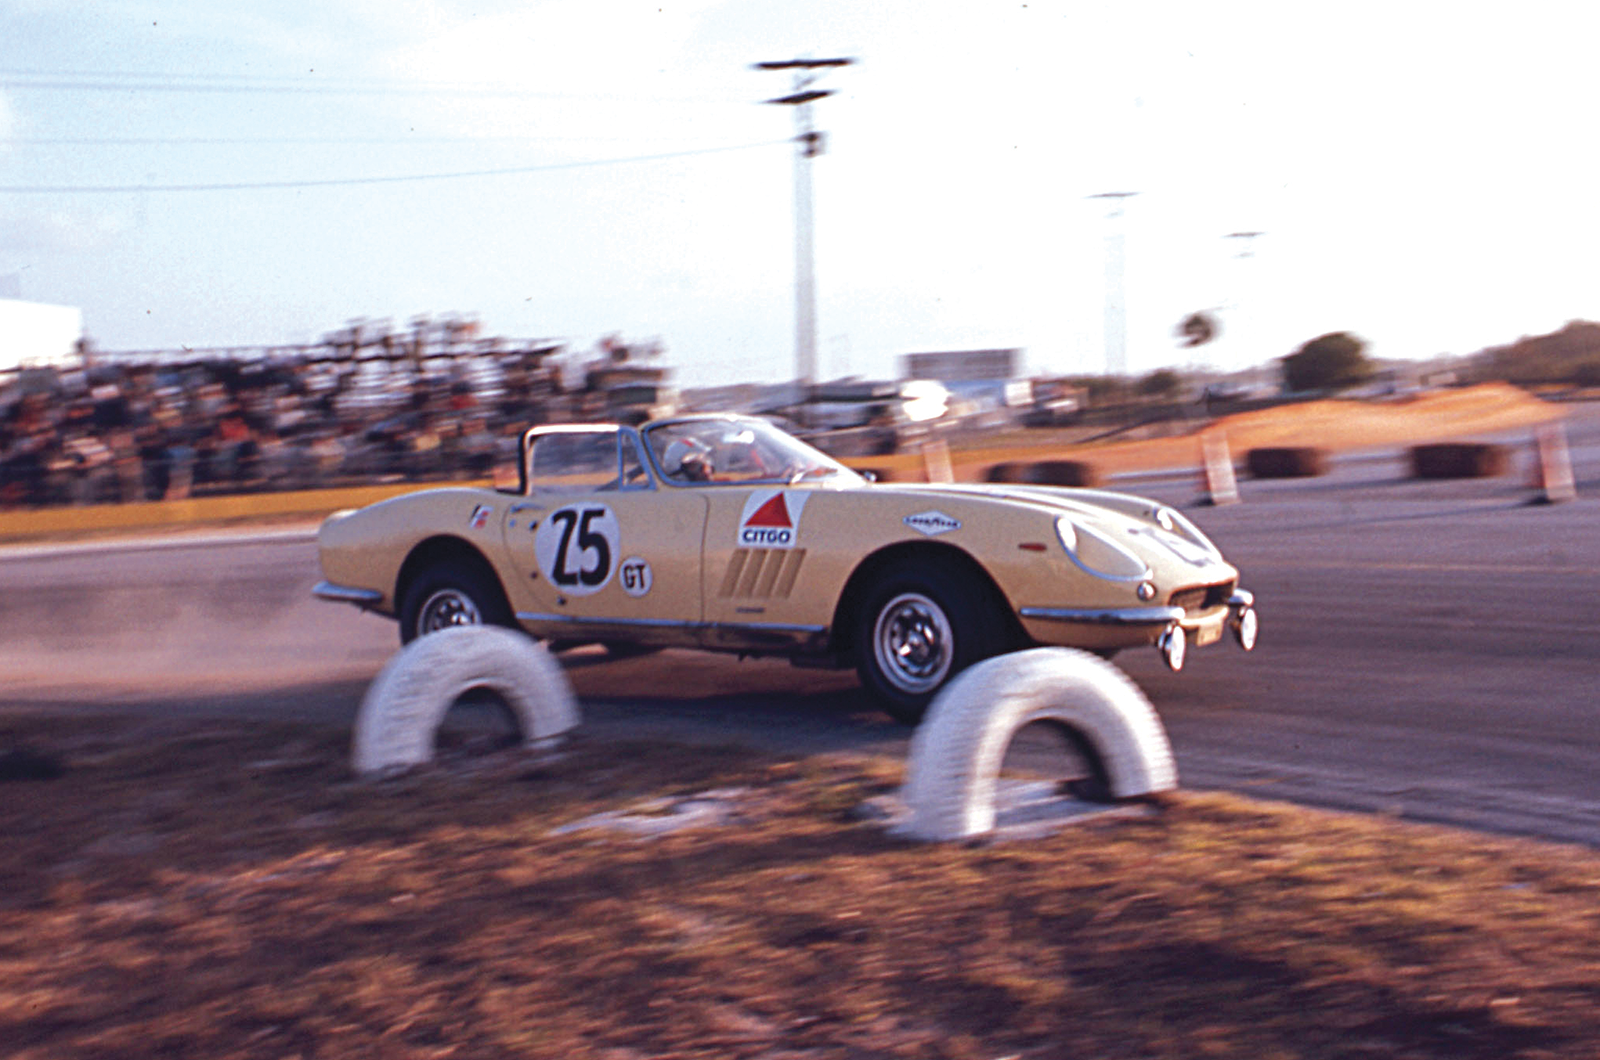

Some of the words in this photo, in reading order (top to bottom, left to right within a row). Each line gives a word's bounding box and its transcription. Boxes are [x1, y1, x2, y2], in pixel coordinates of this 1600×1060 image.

[551, 508, 611, 587] 25
[743, 529, 791, 543] CITGO
[623, 564, 645, 589] GT
